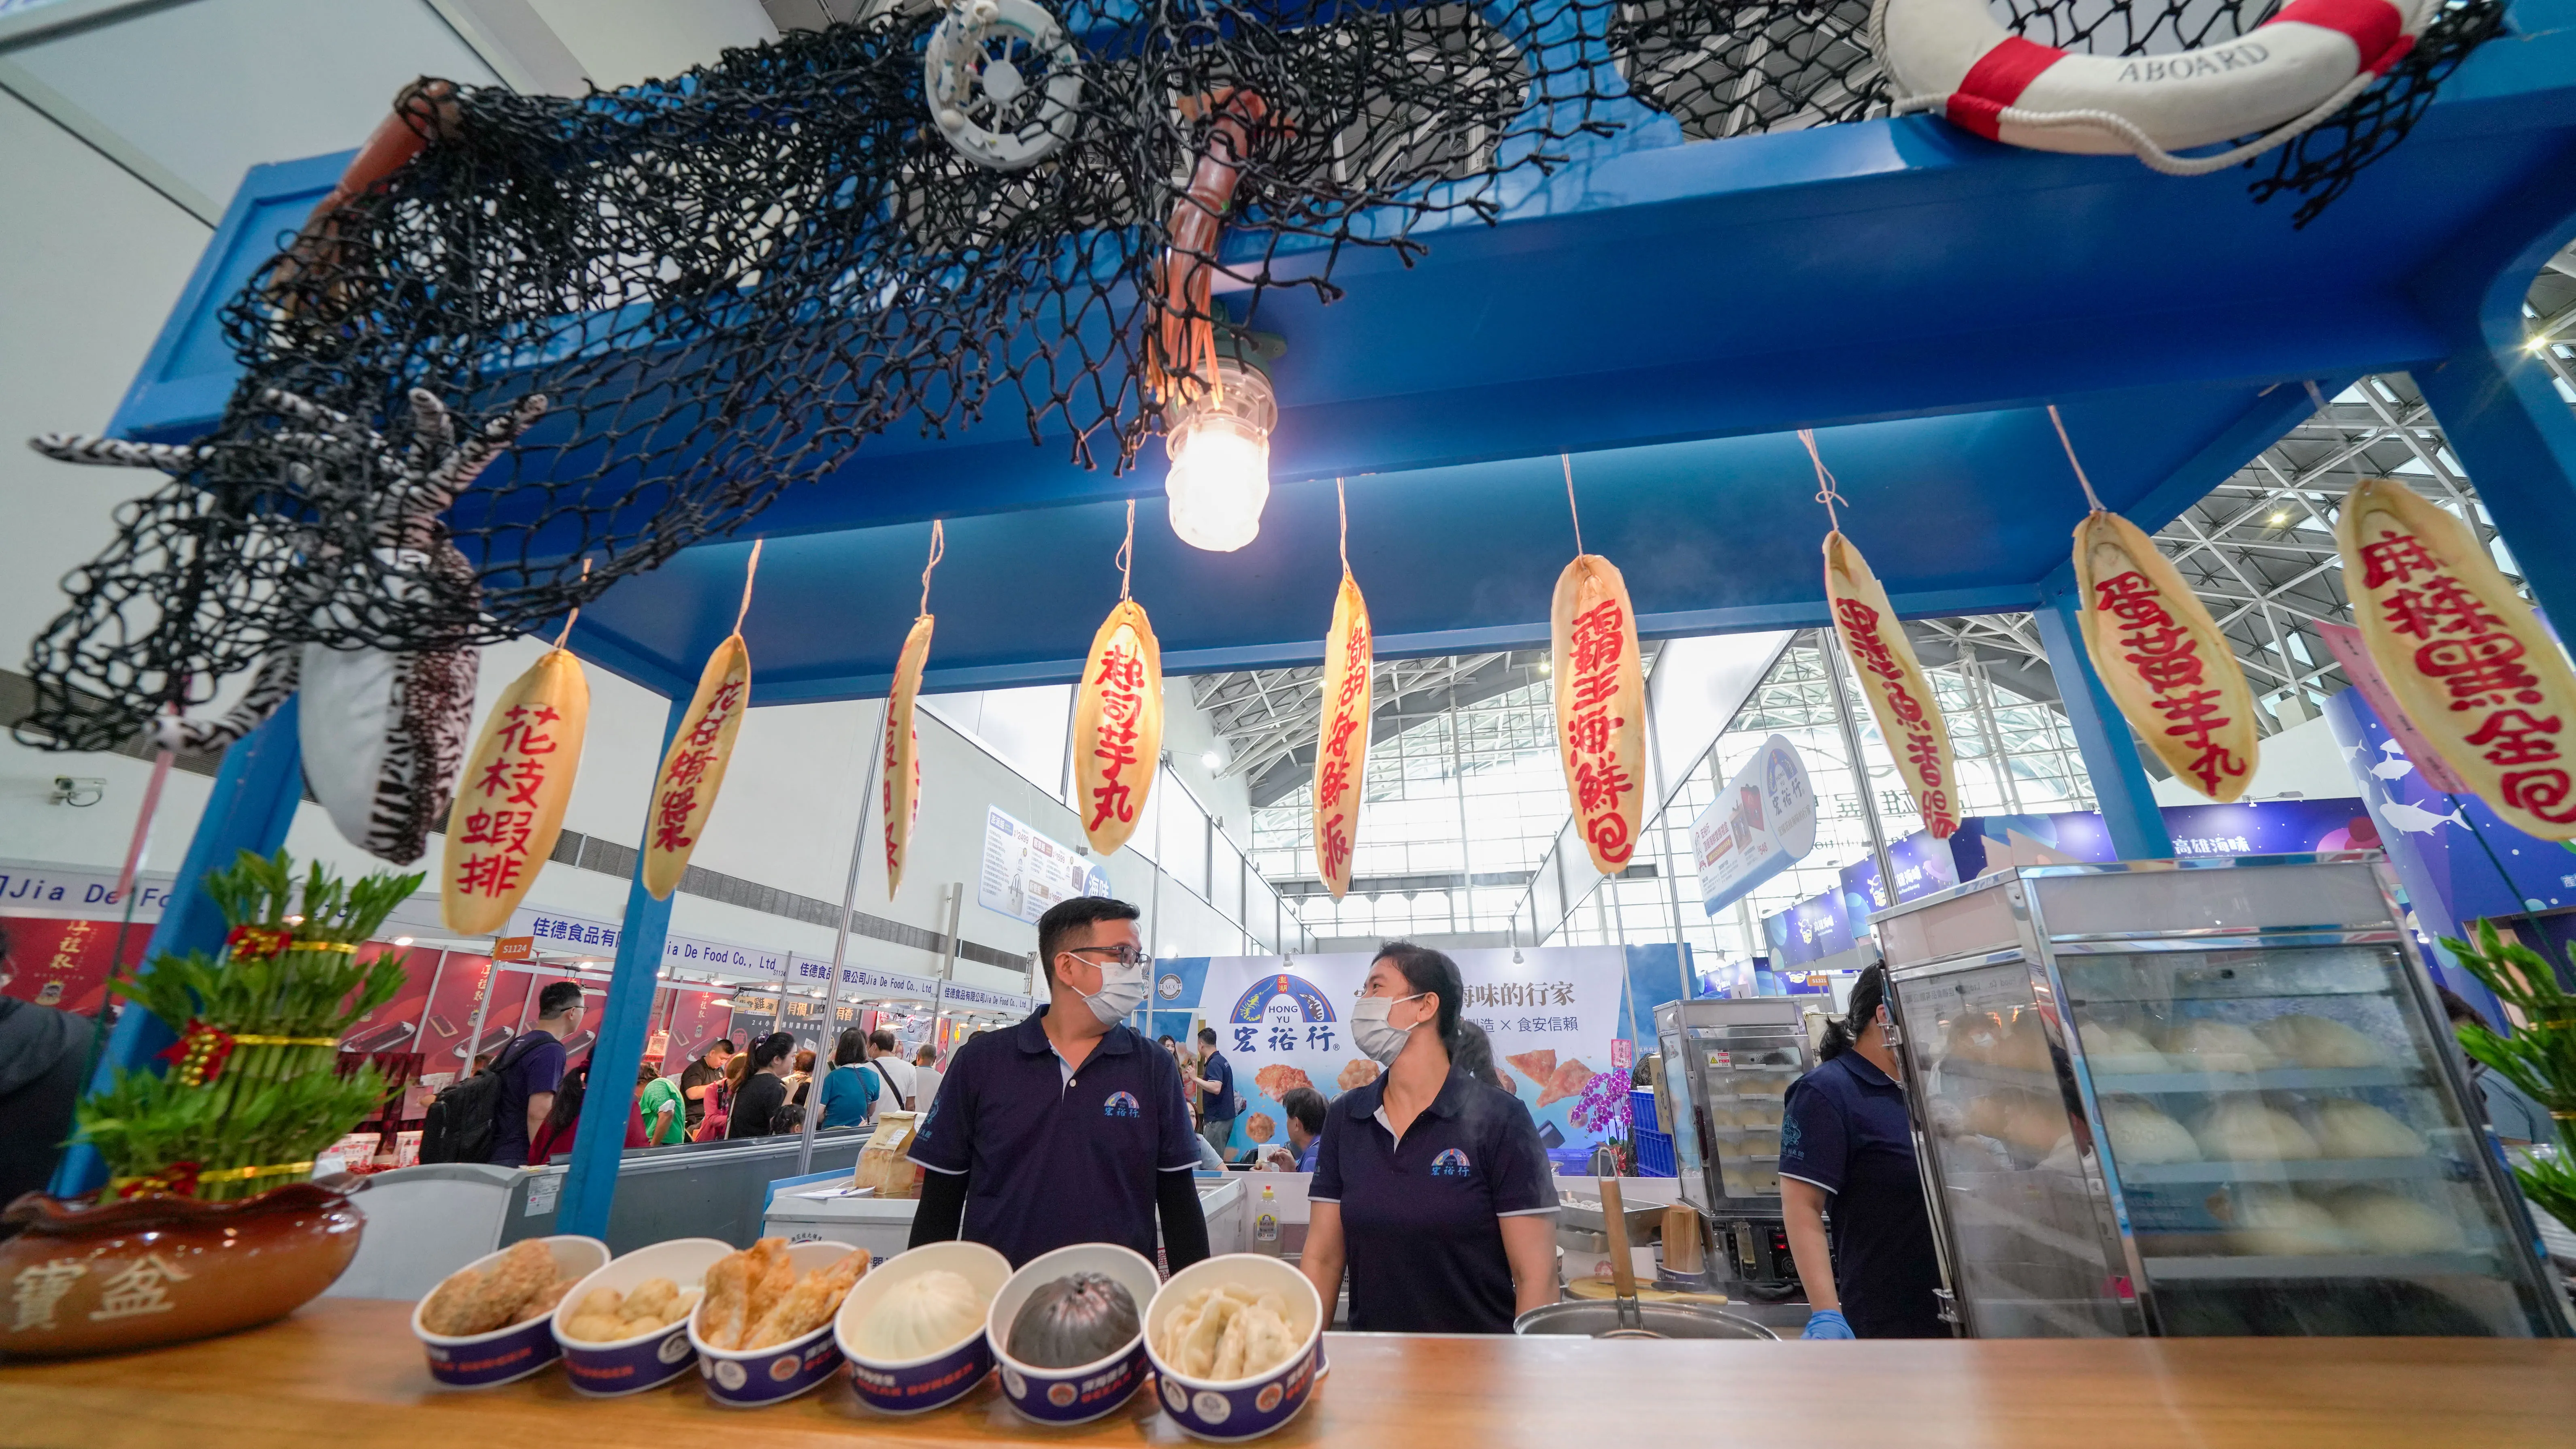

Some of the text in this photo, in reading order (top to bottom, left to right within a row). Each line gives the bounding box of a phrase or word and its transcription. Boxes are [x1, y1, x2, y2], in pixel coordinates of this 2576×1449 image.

[2118, 43, 2269, 83] ABOARD
[2095, 571, 2247, 797] 蛋黃芋丸
[1089, 644, 1145, 831] 起司芋丸
[1569, 599, 1633, 863] 霸王海鮮包
[457, 704, 560, 897] 花枝蝦排
[2172, 836, 2250, 854] 高雄海味
[85, 884, 119, 903] De
[502, 944, 527, 954] S1124
[664, 940, 776, 970] ia De Food Co., Ltd
[880, 976, 887, 987] De
[891, 978, 905, 989] Food
[922, 983, 932, 993] Ltd
[1278, 976, 1288, 992] 澎湖
[1000, 997, 1008, 1006] Food
[1518, 1016, 1578, 1032] 食安信賴
[1233, 1025, 1335, 1052] 宏裕行
[1105, 1106, 1139, 1118] 宏裕行
[1431, 1166, 1469, 1177] 宏裕行
[9, 1254, 192, 1332] 寶盆
